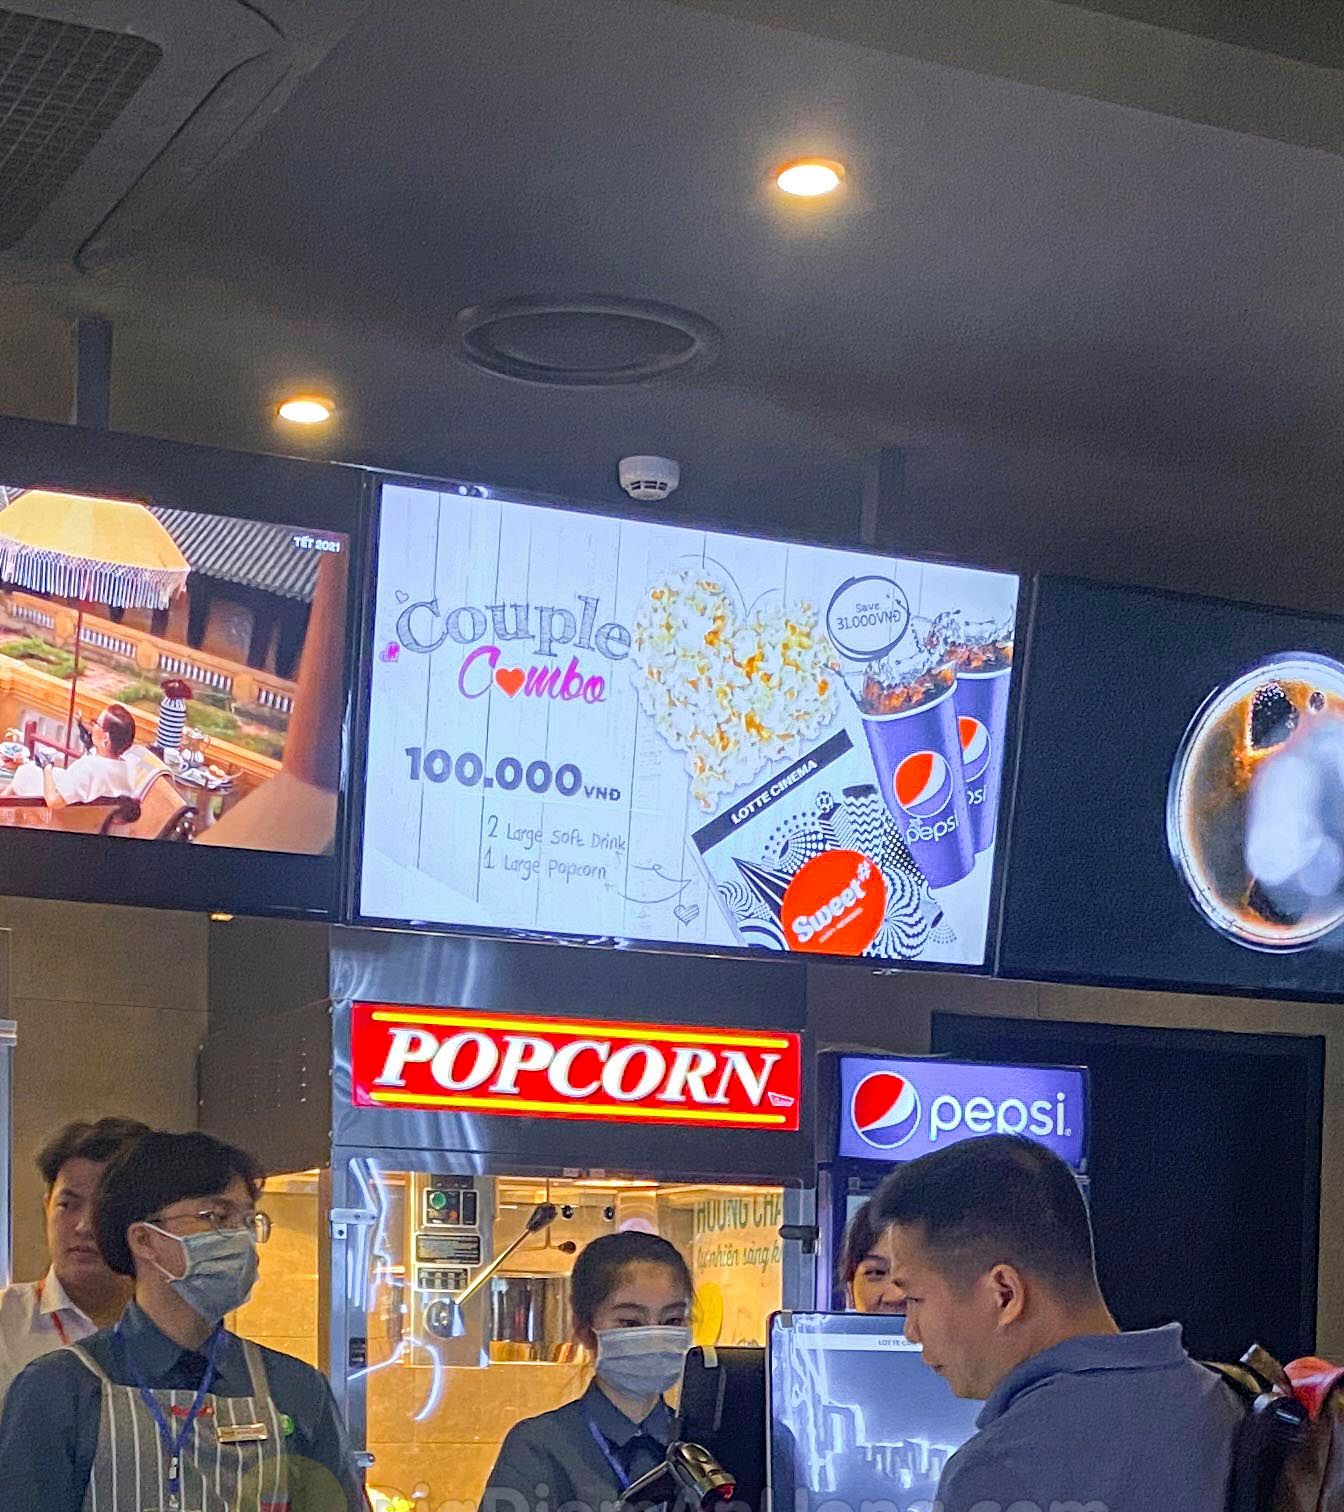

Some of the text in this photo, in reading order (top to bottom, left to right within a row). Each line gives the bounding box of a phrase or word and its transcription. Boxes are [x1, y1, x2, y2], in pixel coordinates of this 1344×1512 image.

[396, 594, 632, 661] Couple
[405, 747, 582, 797] 100.000
[730, 757, 819, 826] LOTTE CINEMA
[487, 814, 499, 838] 2
[506, 823, 544, 850] Large
[906, 809, 960, 845] pepsi
[483, 847, 496, 870] 1
[504, 854, 542, 881] Large
[373, 1026, 781, 1107] POPCORN
[928, 1091, 1068, 1141] pepsi
